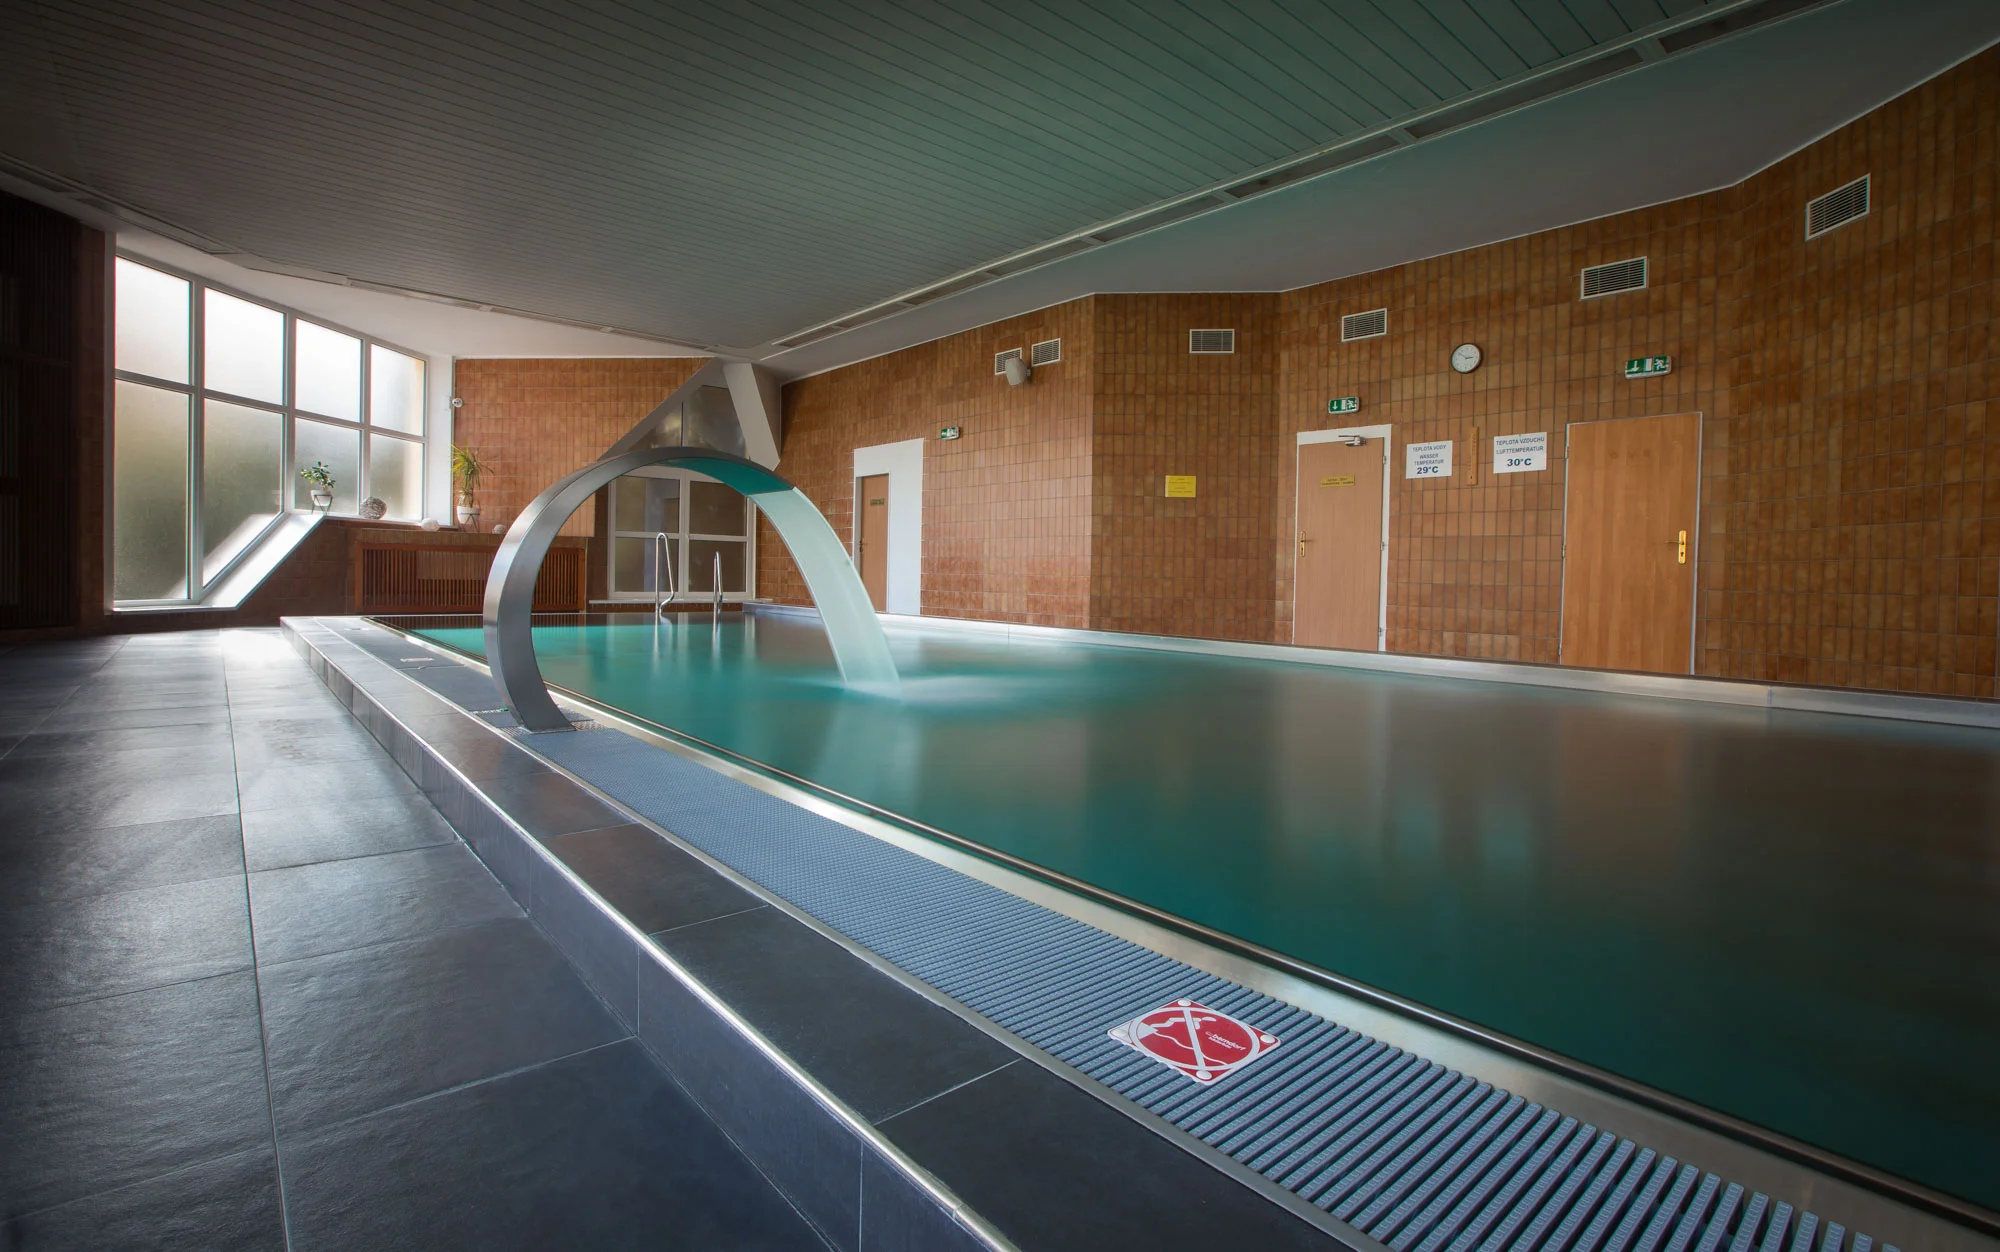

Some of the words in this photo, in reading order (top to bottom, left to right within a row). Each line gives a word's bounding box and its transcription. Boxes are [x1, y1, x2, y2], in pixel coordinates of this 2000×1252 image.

[1519, 436, 1545, 444] VZDUCHU
[1496, 445, 1544, 455] LUFTTEMPERATUR
[1506, 457, 1532, 467] 30°C
[1416, 465, 1439, 475] 29°C
